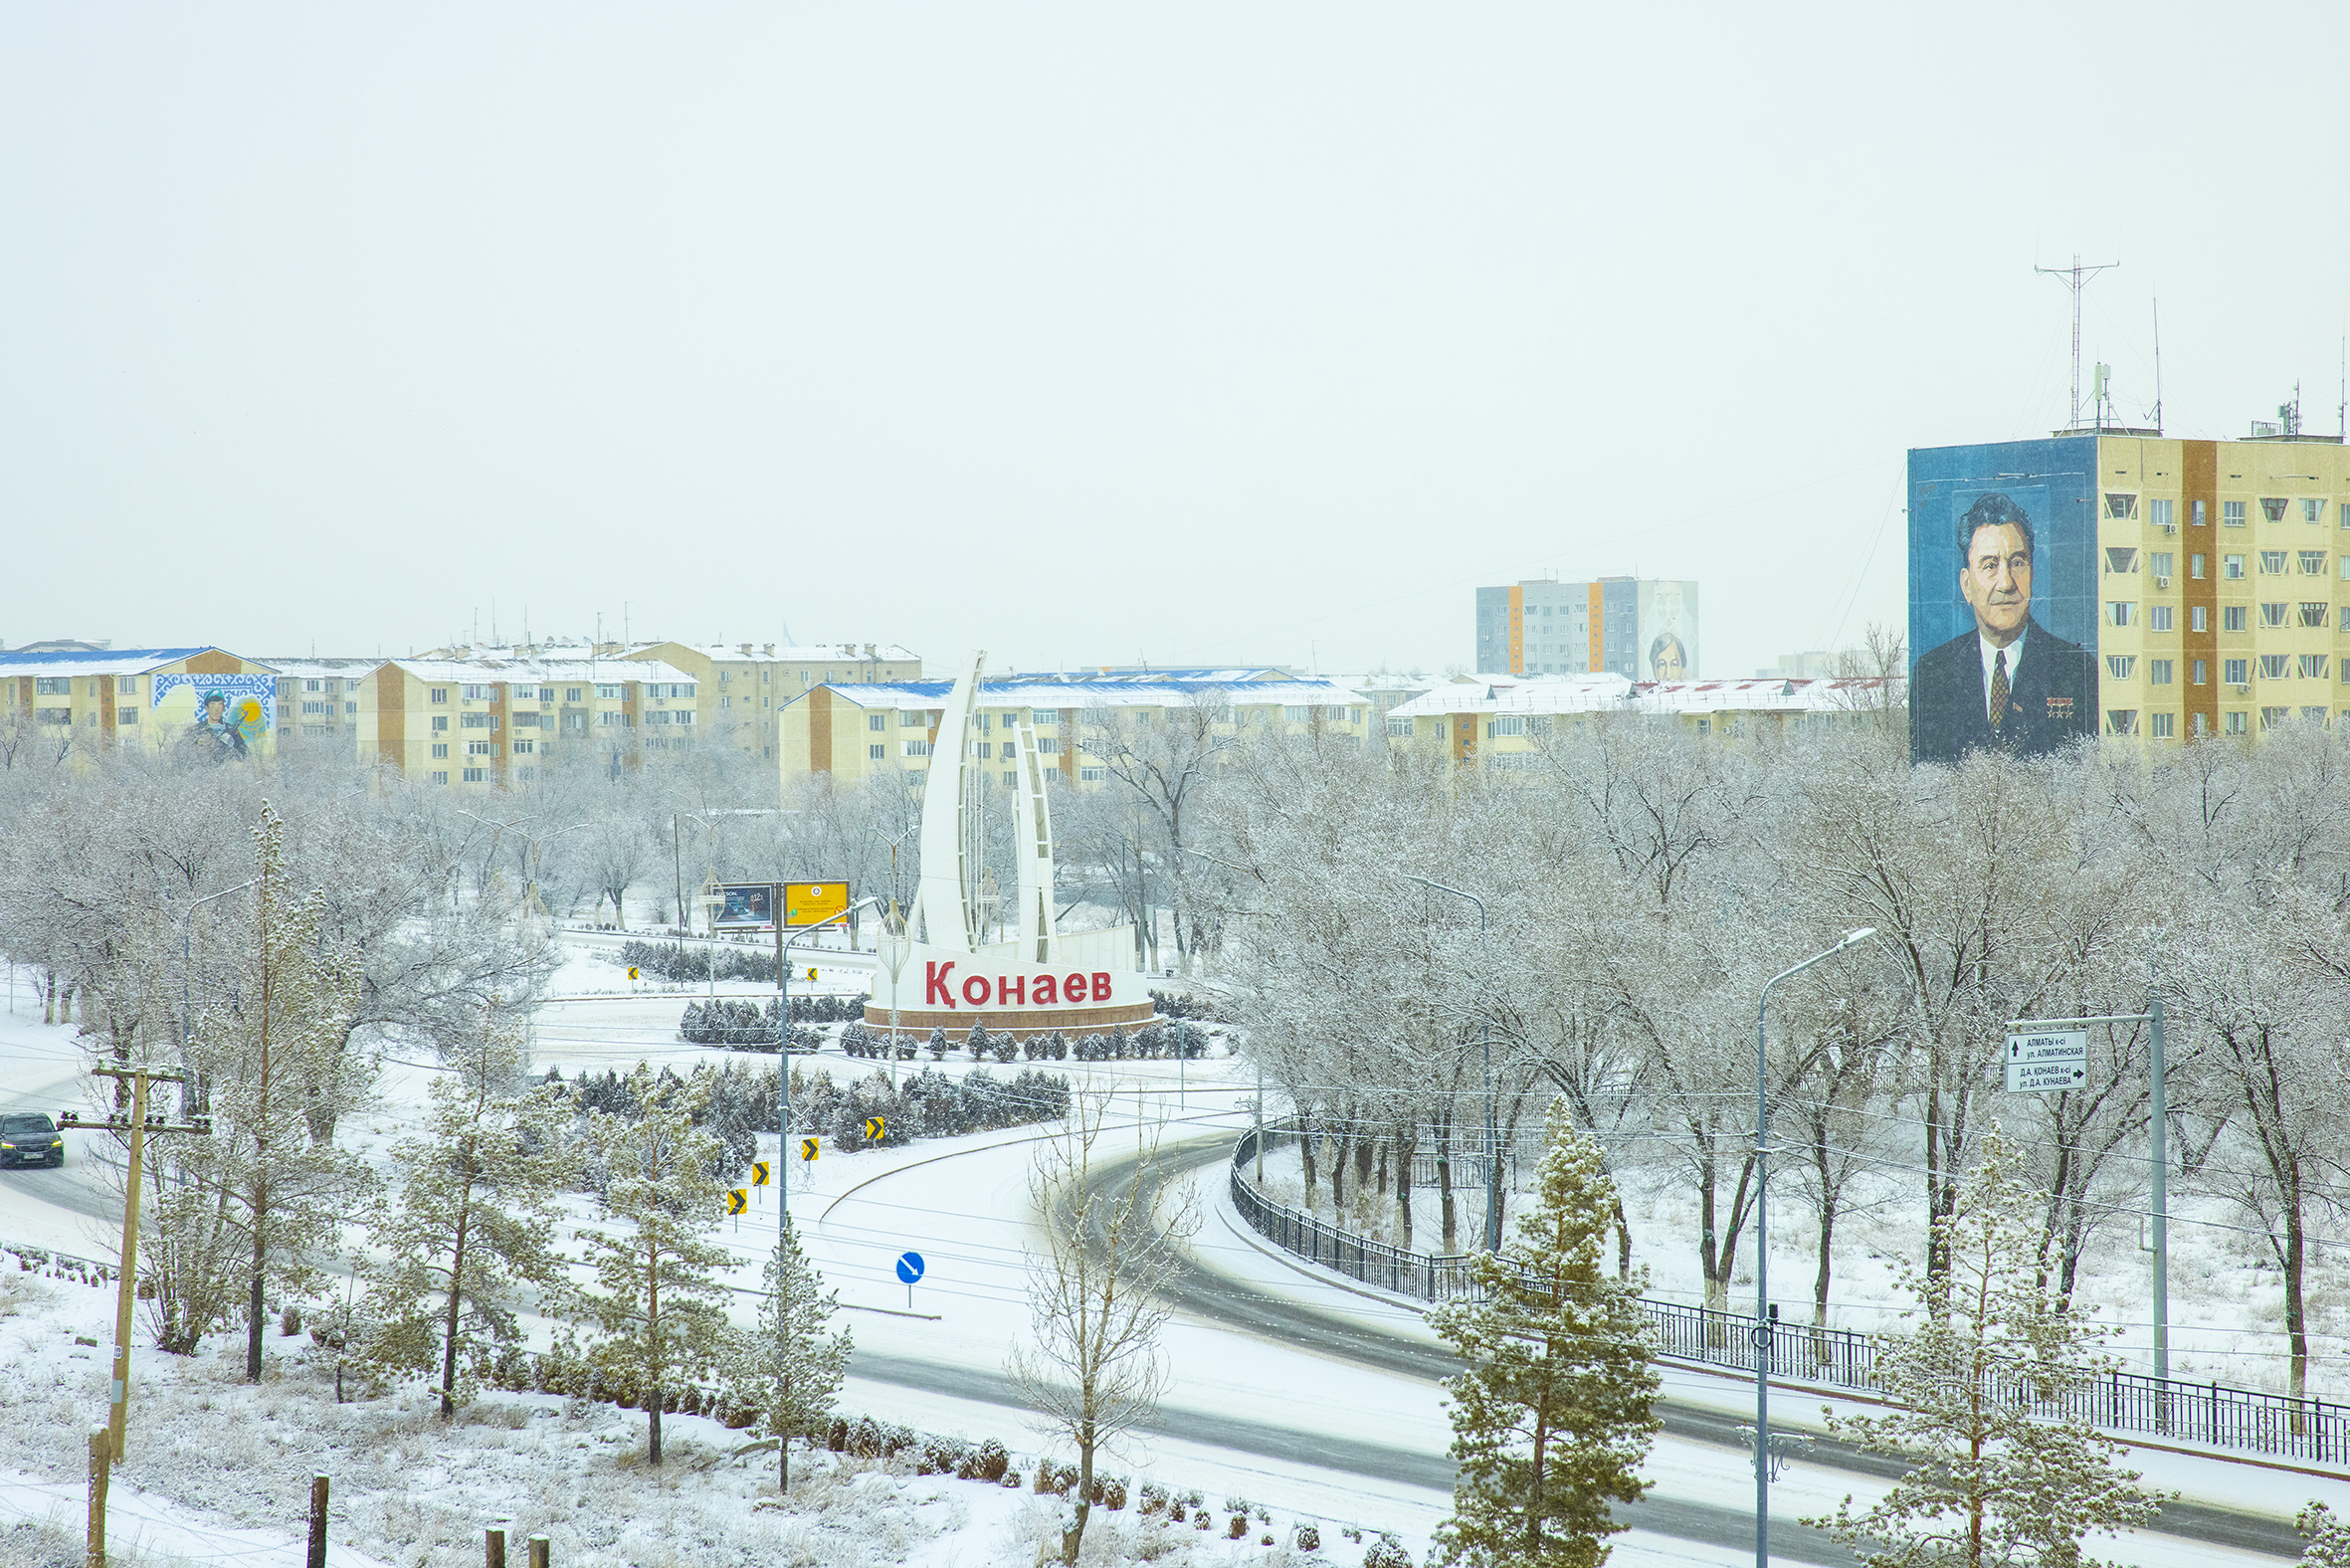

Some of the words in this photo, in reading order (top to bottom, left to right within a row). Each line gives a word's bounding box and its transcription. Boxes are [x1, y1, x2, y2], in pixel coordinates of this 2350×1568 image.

[925, 960, 1112, 1009] Қонаев
[2027, 1038, 2055, 1047] АЛМАТЫ
[2026, 1051, 2037, 1060] ул.
[2037, 1047, 2083, 1058] АЛМАТИНСКАЯ
[2020, 1068, 2033, 1078] Д.А.
[2019, 1080, 2029, 1089] ул.
[2029, 1078, 2042, 1087] Д.А.
[2043, 1077, 2072, 1085] КУНАЕВА
